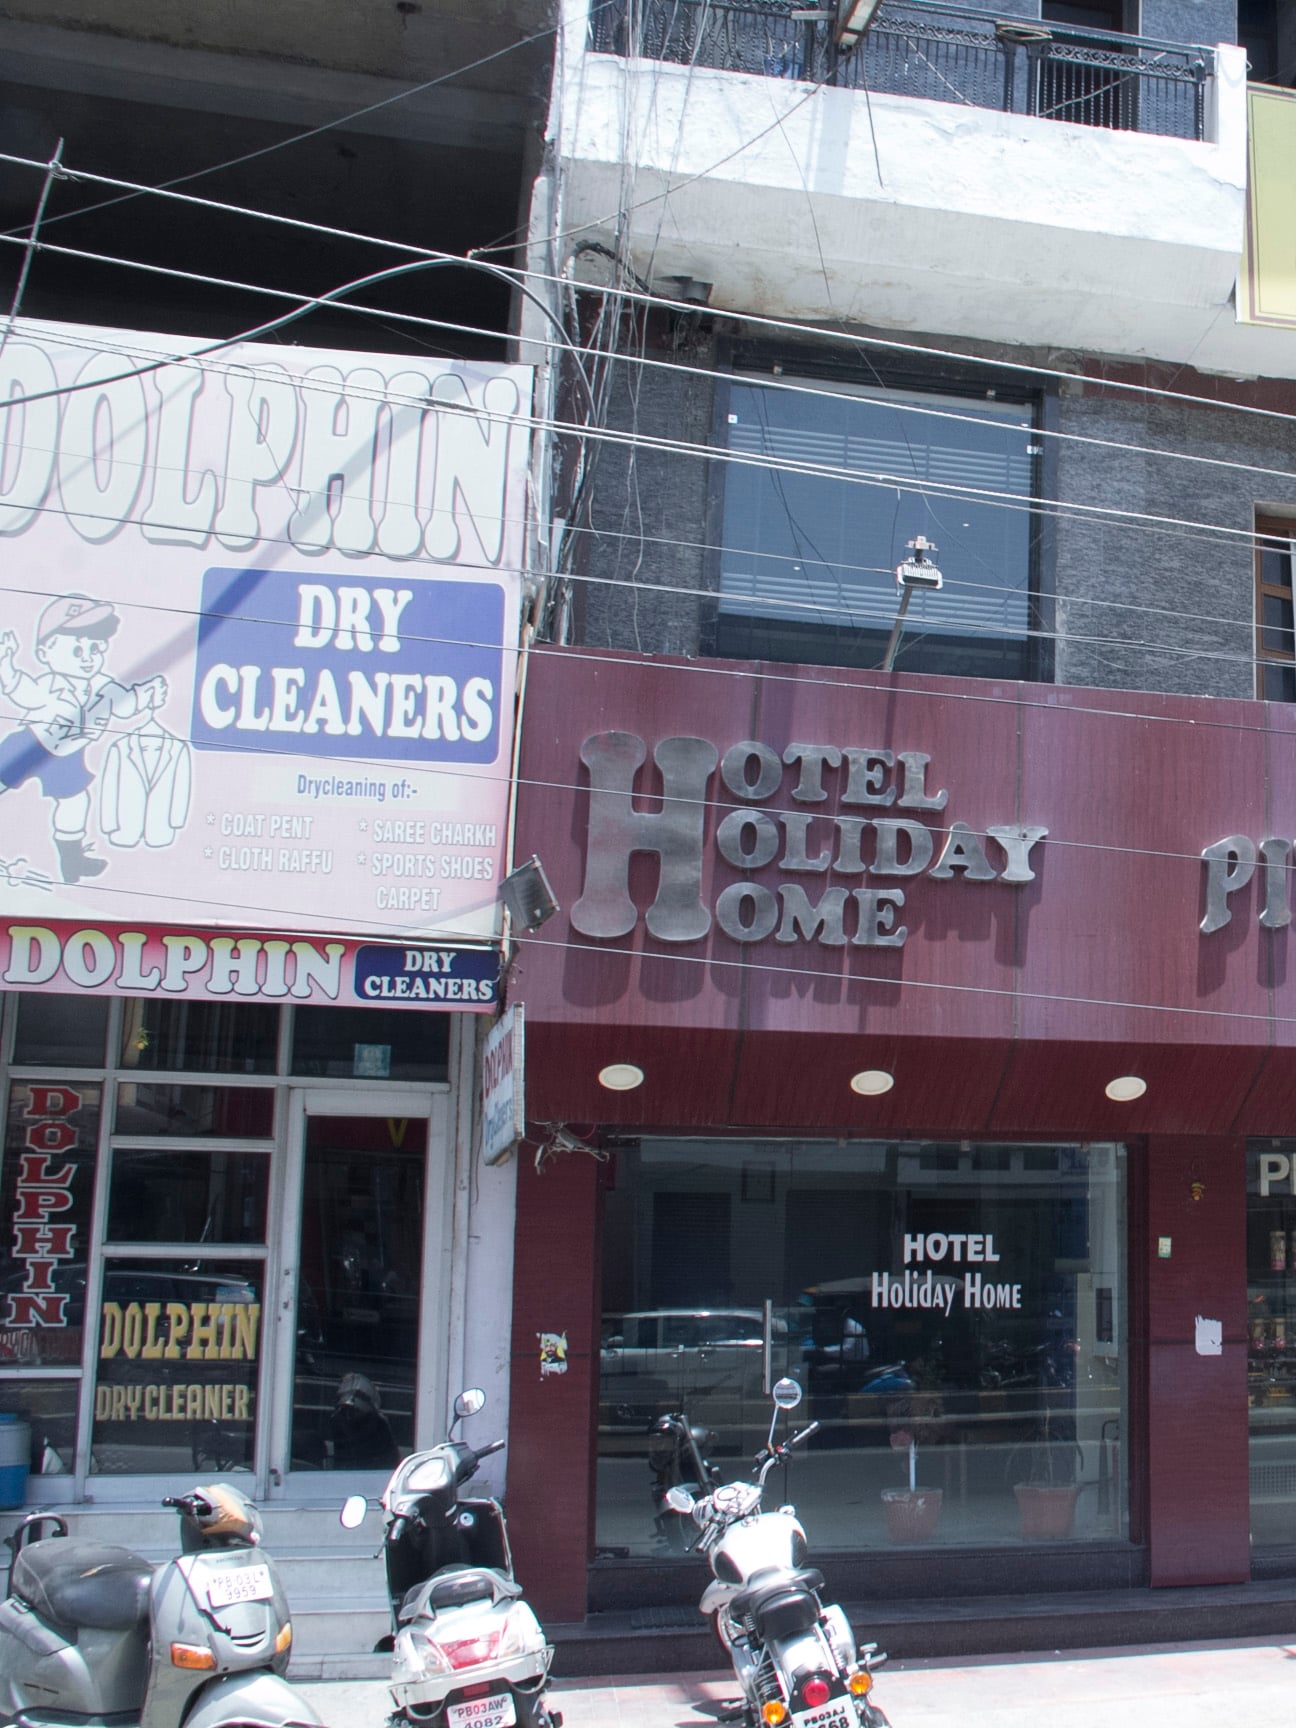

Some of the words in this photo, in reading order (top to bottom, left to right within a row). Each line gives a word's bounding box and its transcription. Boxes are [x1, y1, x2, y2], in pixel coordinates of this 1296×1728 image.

[293, 583, 414, 653] DRY
[200, 662, 495, 742] CLEANERS
[296, 774, 386, 802] Drycleaning
[220, 813, 266, 836] COAT
[269, 816, 314, 840] PENT
[373, 820, 425, 845] SAREE
[218, 846, 273, 871] CLOTH
[278, 850, 333, 874] RAFFU
[371, 853, 435, 878] SPORTS
[440, 857, 494, 880] SHOES
[376, 886, 441, 912] CARPET
[2, 924, 345, 1000] DOLPHIN
[403, 950, 458, 974] DRY
[363, 976, 494, 1001] CLEANERS
[5, 1085, 82, 1328] DOLPHIN
[903, 1232, 1001, 1265] HOTEL
[100, 1301, 261, 1361] DOLPHIN
[95, 1385, 143, 1422] DRY
[144, 1384, 251, 1421] CLEANER
